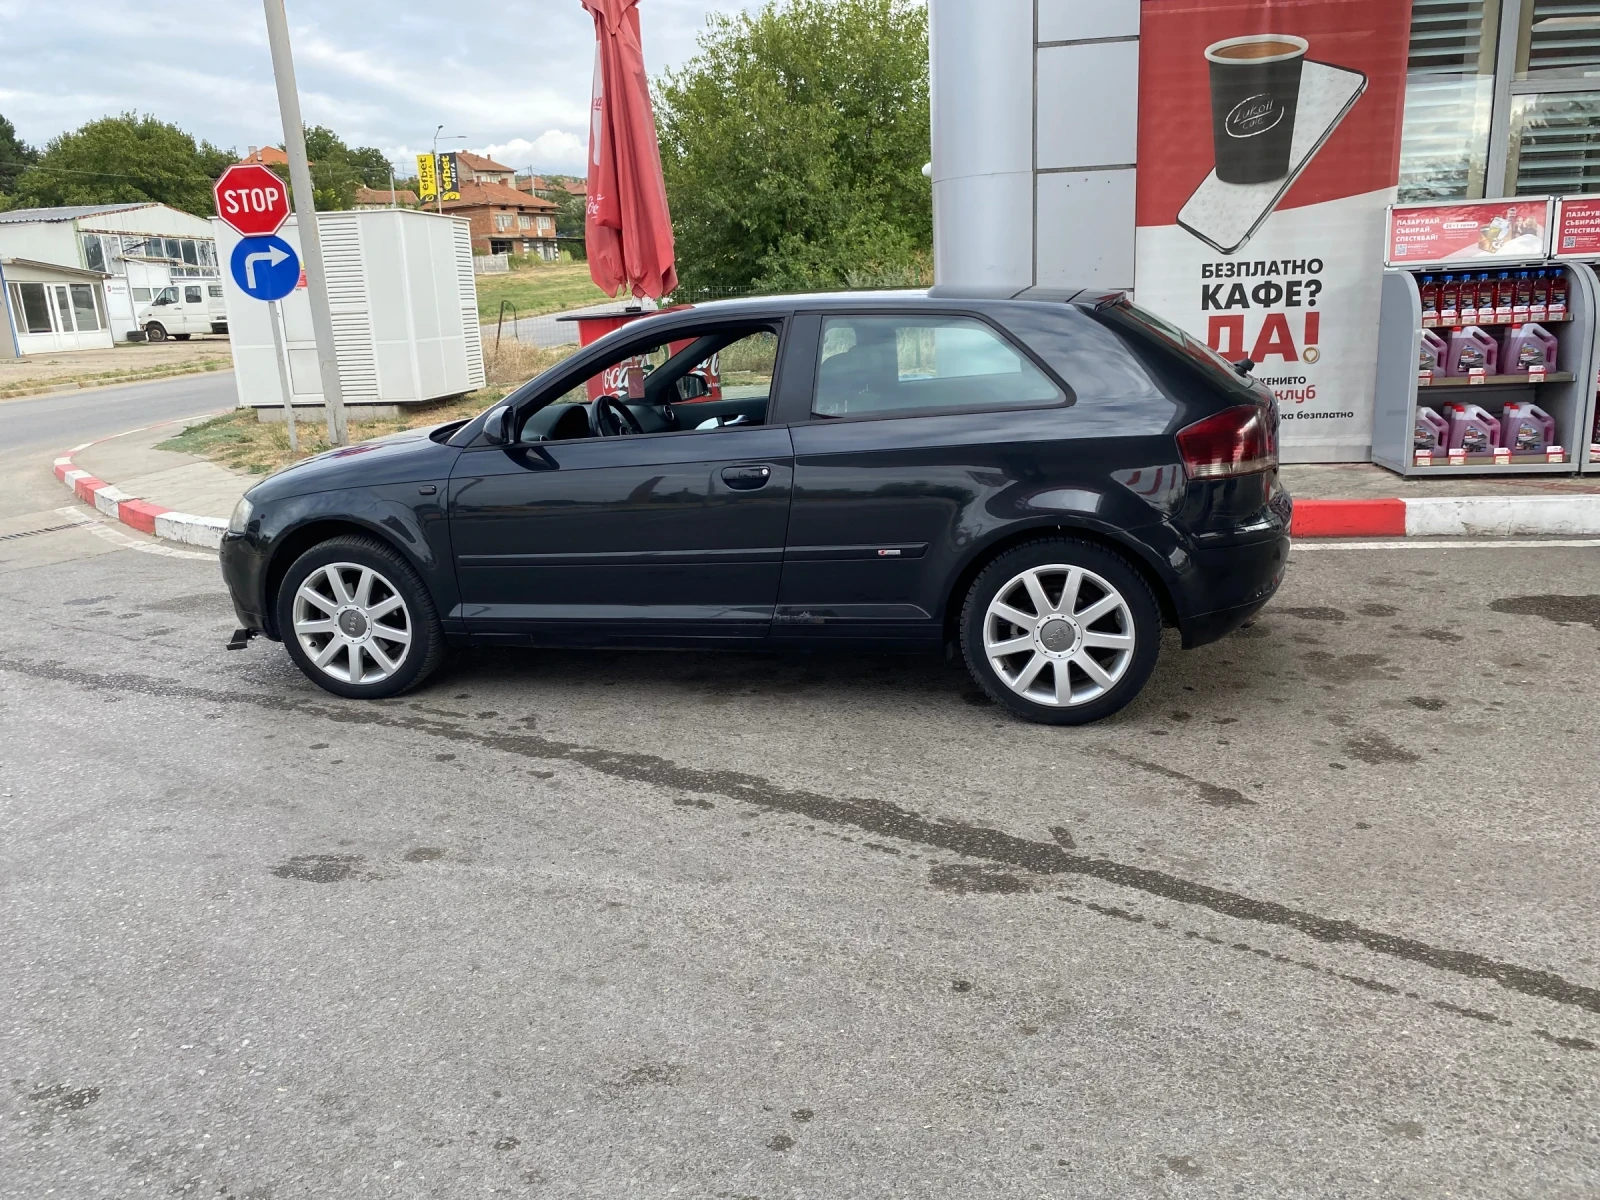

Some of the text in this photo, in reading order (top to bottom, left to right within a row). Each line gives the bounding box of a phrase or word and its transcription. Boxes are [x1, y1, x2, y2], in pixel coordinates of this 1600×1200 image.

[420, 157, 429, 191] efbet
[441, 155, 452, 190] efbet
[224, 187, 279, 214] STOP
[1395, 234, 1439, 243] СПЕСТЯВАЙ!
[1201, 258, 1324, 279] БЕЗПЛАТНО
[1201, 279, 1323, 311] КАФЕ?
[1207, 311, 1321, 364] ДА!
[1274, 385, 1316, 404] клуб
[1280, 411, 1354, 420] ка безплатно
